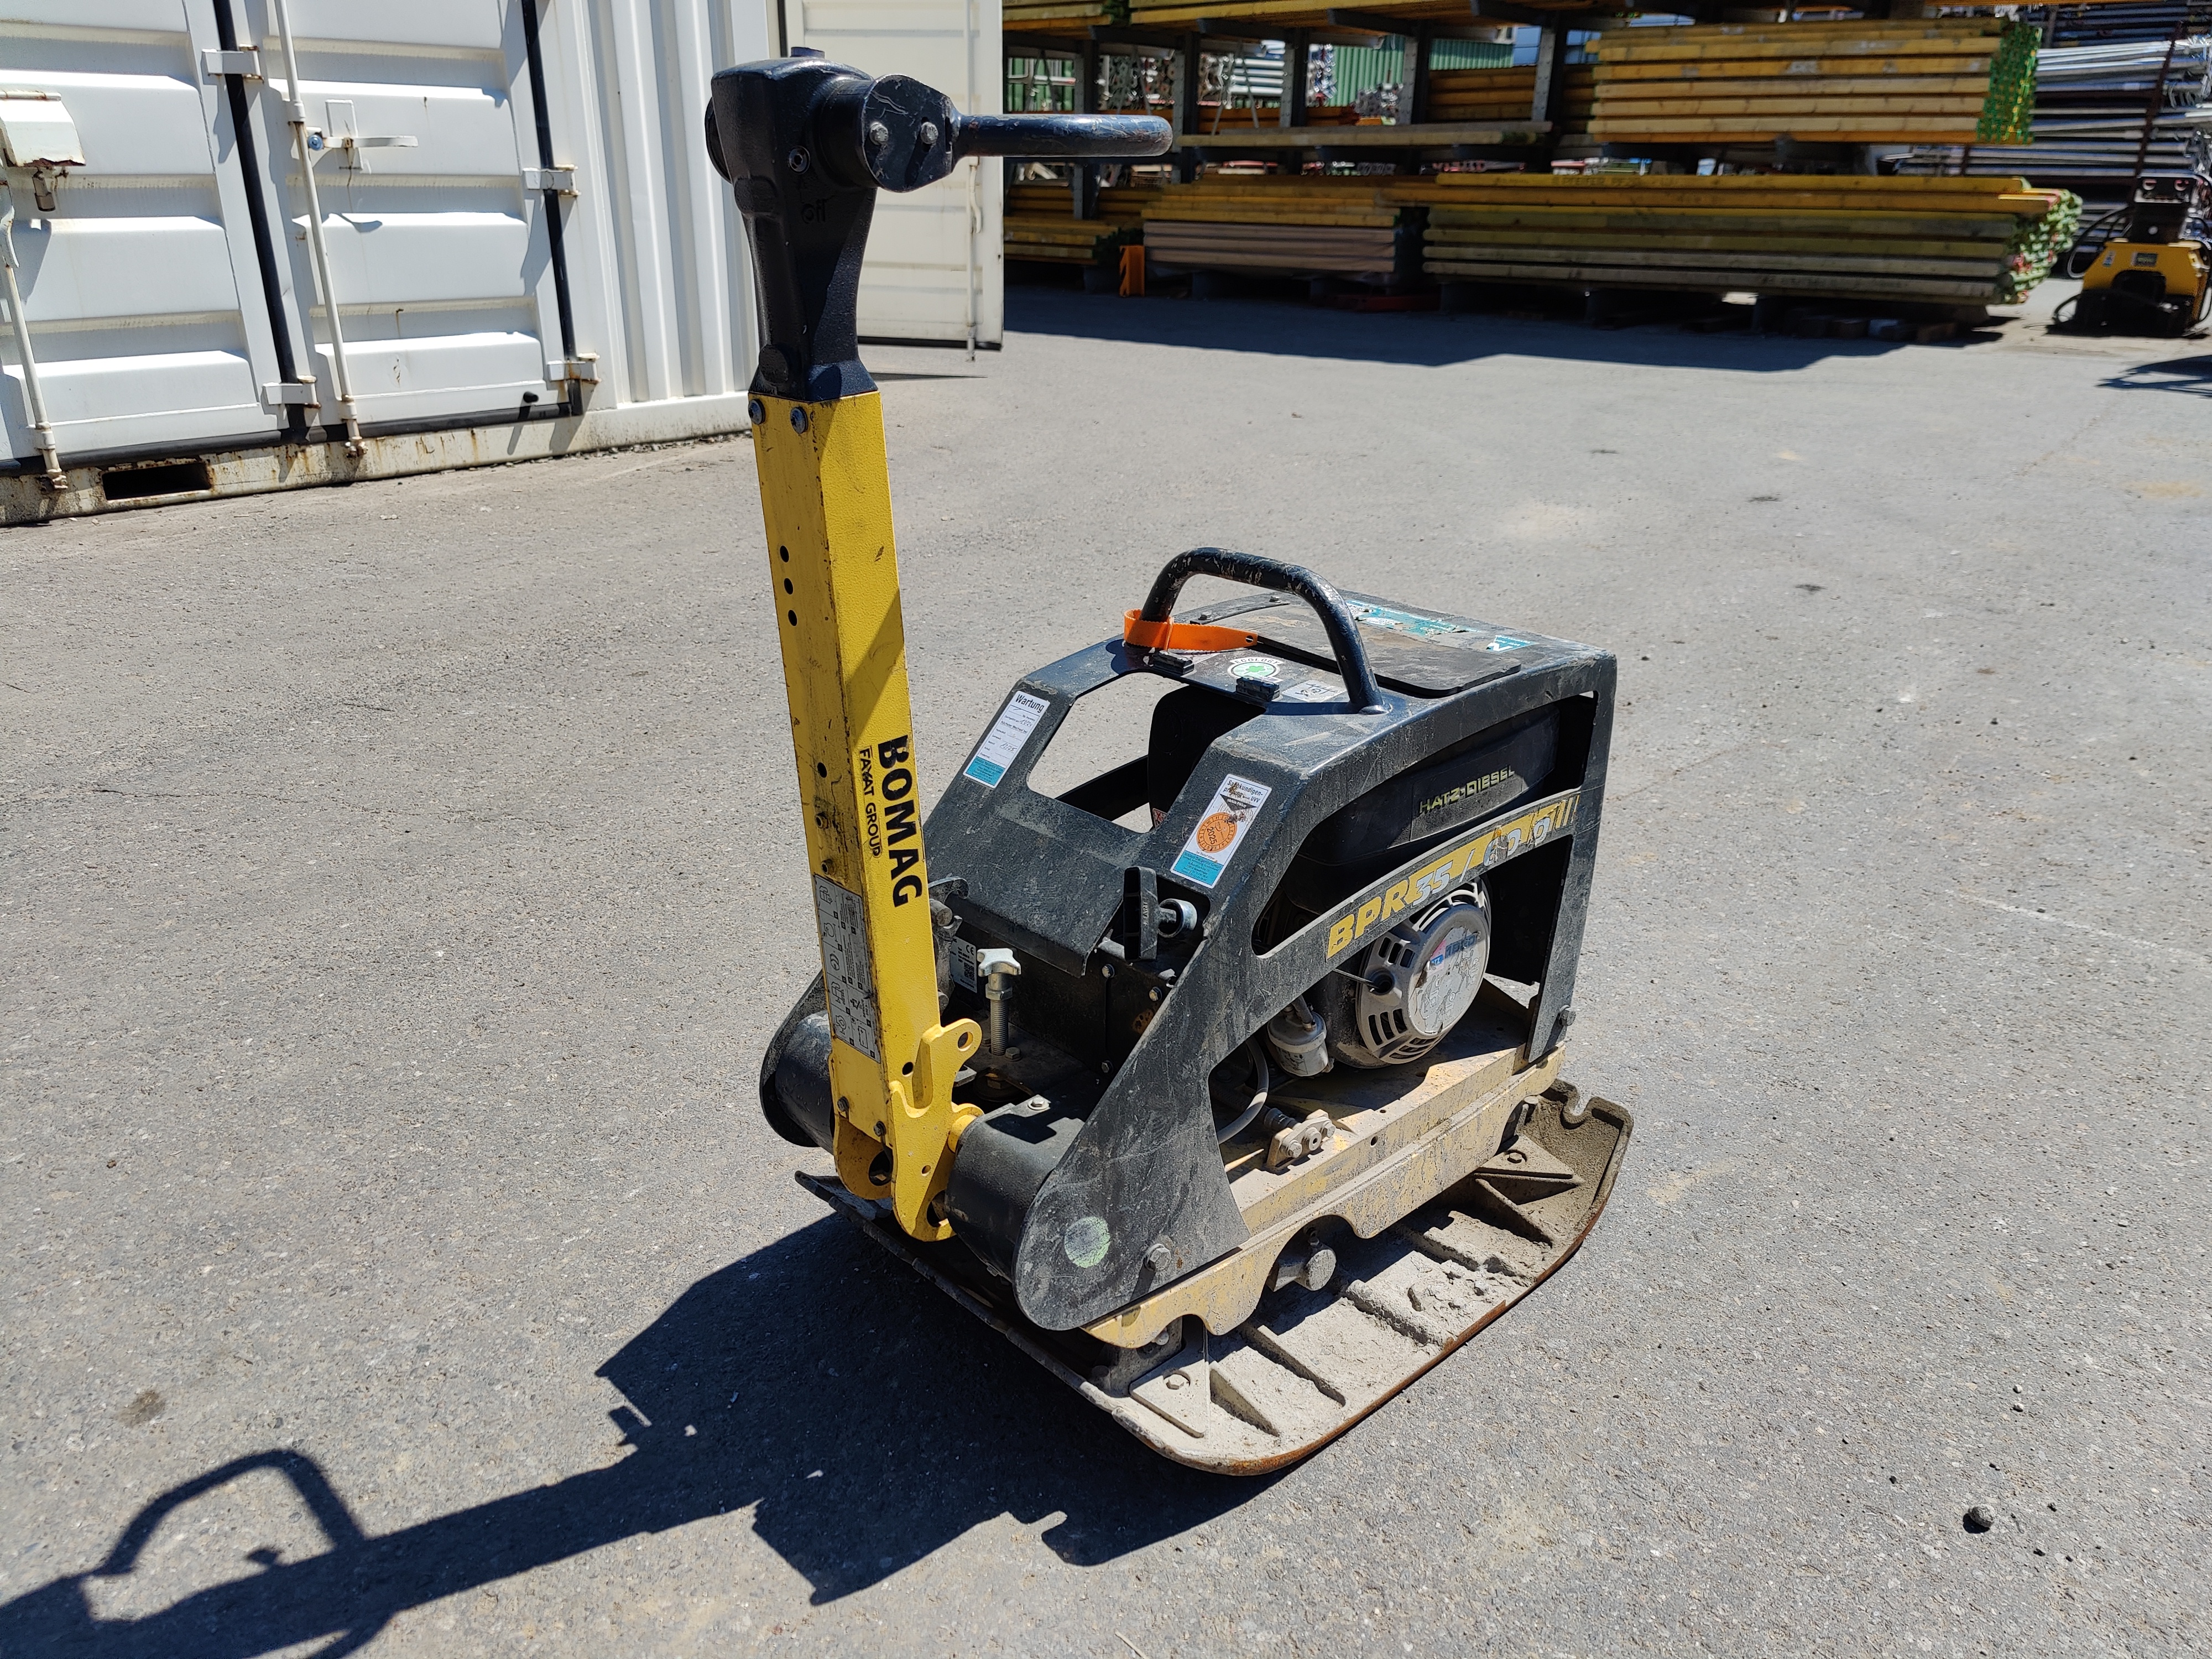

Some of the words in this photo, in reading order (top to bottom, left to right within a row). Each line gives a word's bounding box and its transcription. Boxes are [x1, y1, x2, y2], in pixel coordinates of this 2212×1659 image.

[1015, 693, 1045, 713] Wartung
[859, 748, 874, 796] FAYAT
[865, 802, 881, 857] GROUP
[878, 735, 923, 907] BOMAG
[1206, 826, 1217, 845] 2025
[966, 945, 974, 956] CE
